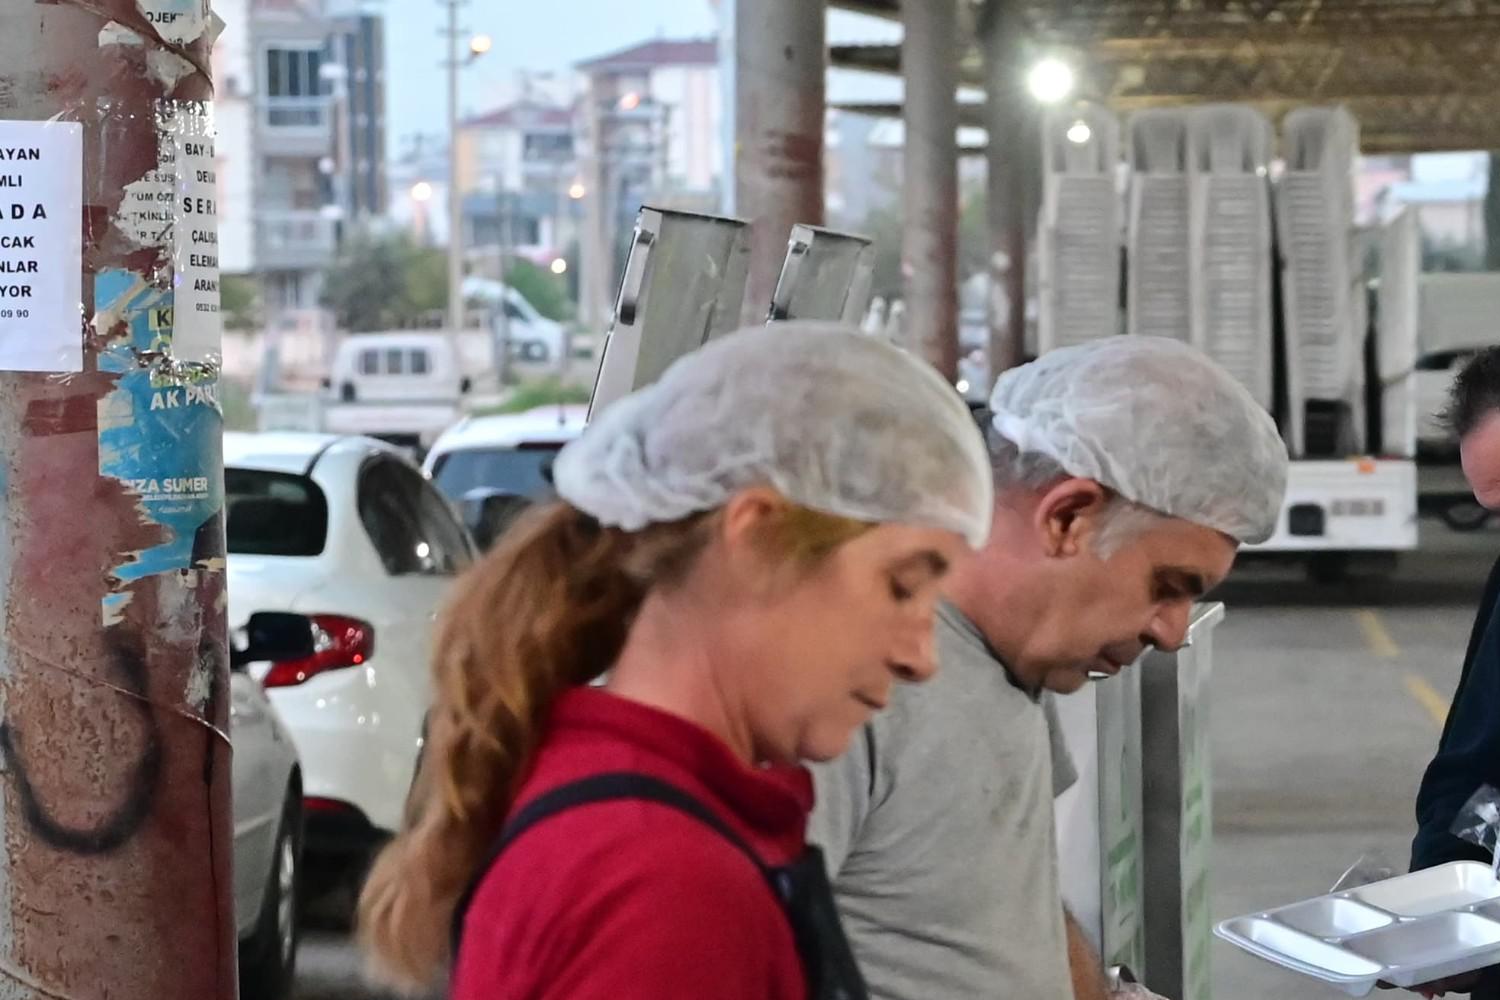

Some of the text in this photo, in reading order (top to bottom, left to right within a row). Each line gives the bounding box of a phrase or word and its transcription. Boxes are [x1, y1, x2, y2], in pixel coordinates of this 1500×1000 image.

[185, 143, 204, 156] BAY
[0, 203, 47, 220] DA
[1, 236, 34, 248] CAK
[1, 309, 29, 318] 09 90
[150, 390, 179, 411] AK
